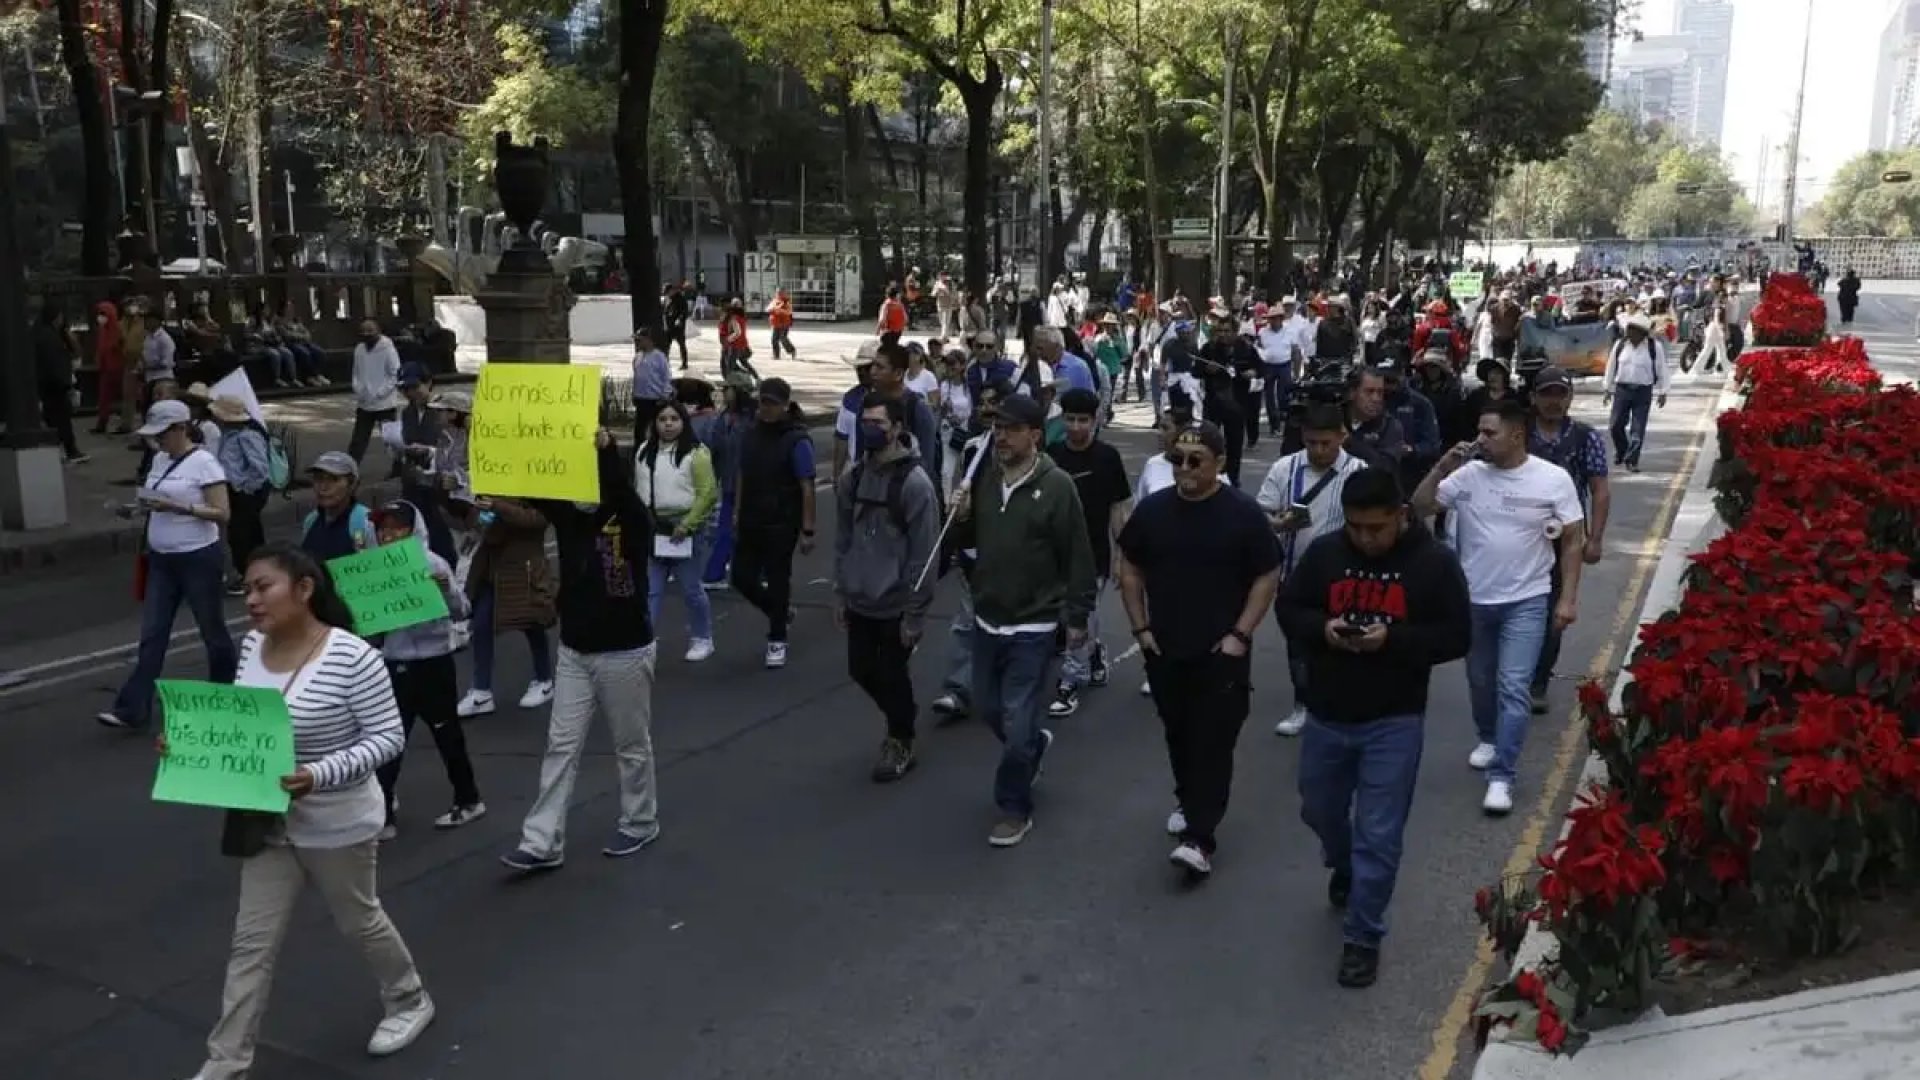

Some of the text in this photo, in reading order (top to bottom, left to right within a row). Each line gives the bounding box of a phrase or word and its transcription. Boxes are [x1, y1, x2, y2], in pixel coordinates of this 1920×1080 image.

[477, 371, 503, 402] No
[560, 374, 585, 407] del
[512, 411, 559, 440] donde
[562, 421, 585, 440] no
[383, 546, 408, 570] del
[161, 684, 190, 713] No
[232, 691, 260, 719] del
[202, 720, 250, 749] donde
[256, 731, 277, 751] no
